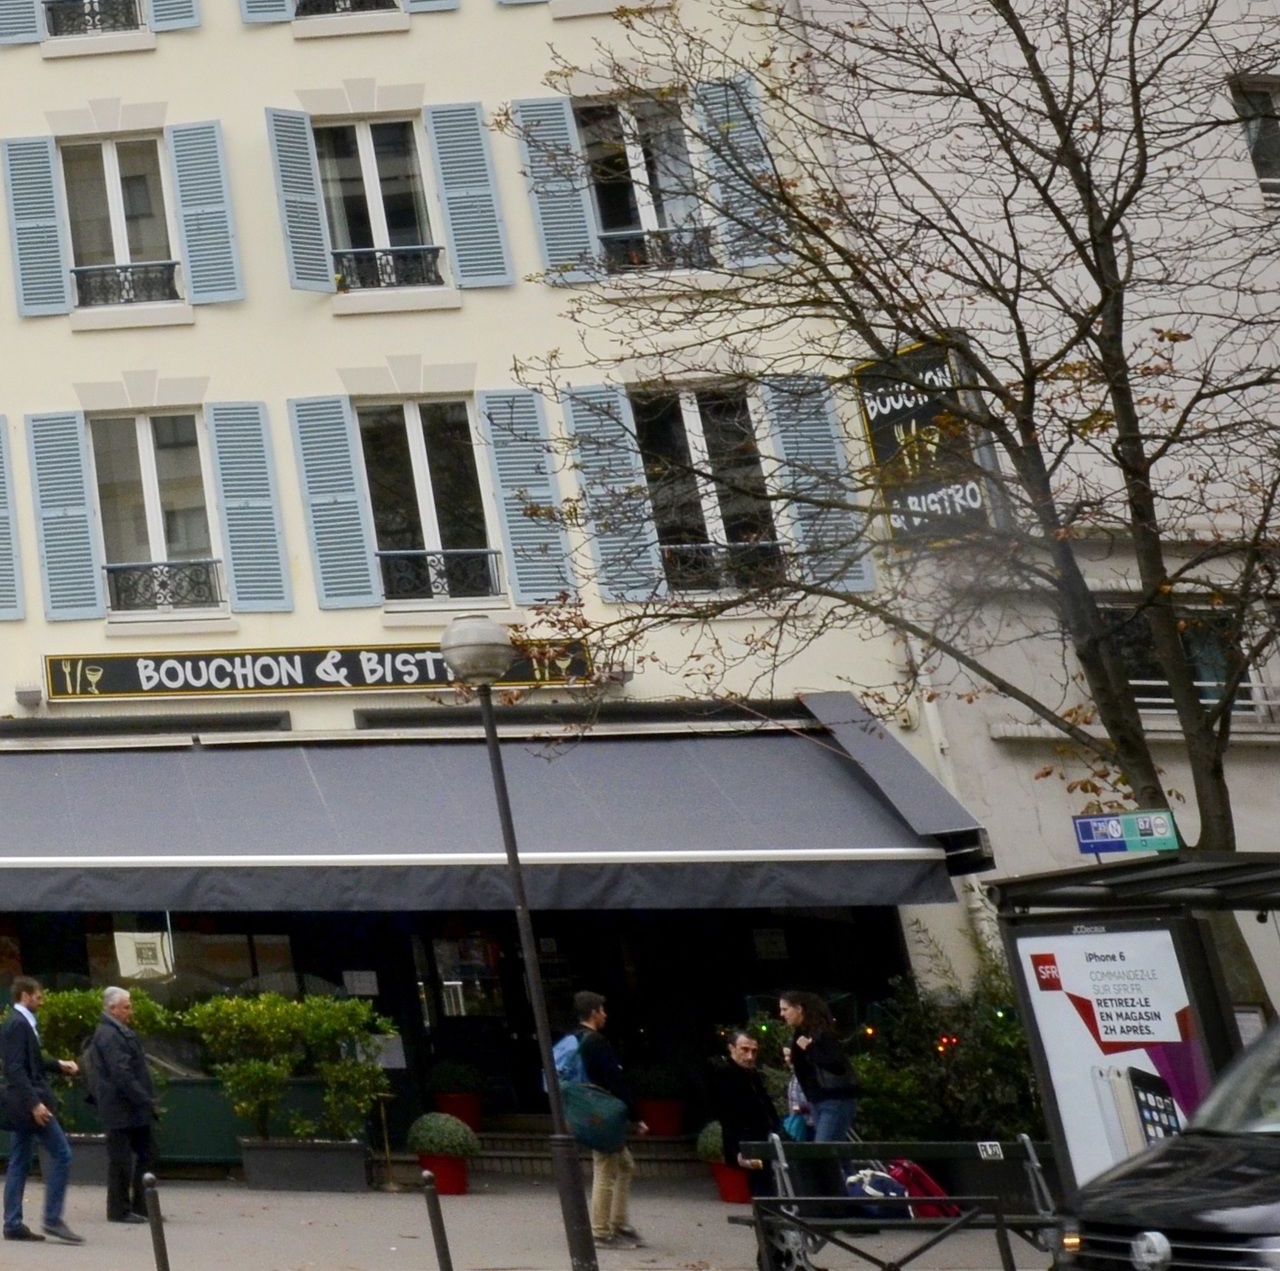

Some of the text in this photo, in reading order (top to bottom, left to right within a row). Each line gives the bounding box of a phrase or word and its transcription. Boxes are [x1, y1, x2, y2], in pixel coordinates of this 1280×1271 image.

[138, 654, 303, 691] BOUCHON
[315, 650, 353, 688] &
[1085, 952, 1126, 962] iPhone 6
[1039, 966, 1059, 978] SFR
[1090, 969, 1158, 981] COMMANDEZ-LE
[1092, 985, 1111, 995] SUR
[1097, 998, 1151, 1008] RETIREZ-LE
[1100, 1011, 1161, 1022] EN MAGASIN
[1104, 1026, 1117, 1035] 2H
